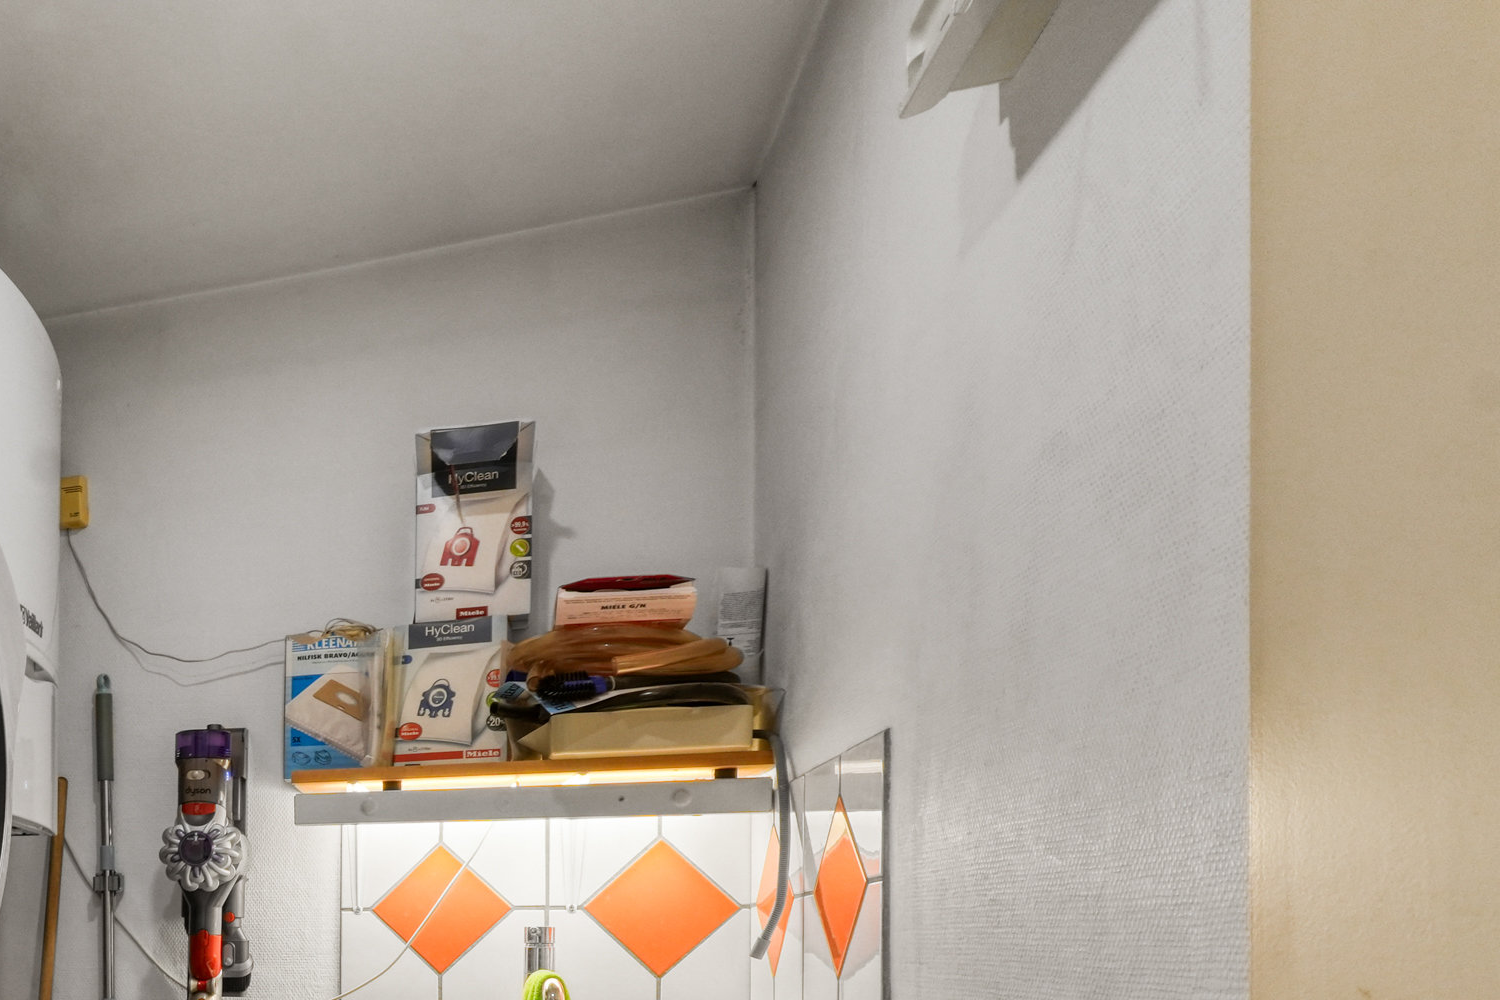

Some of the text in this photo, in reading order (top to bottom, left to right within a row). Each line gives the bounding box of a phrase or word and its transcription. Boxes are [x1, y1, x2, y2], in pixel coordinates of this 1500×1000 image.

[459, 608, 485, 617] Miele
[425, 623, 475, 638] HyClean
[465, 750, 500, 758] Miele
[185, 786, 211, 796] dyson
